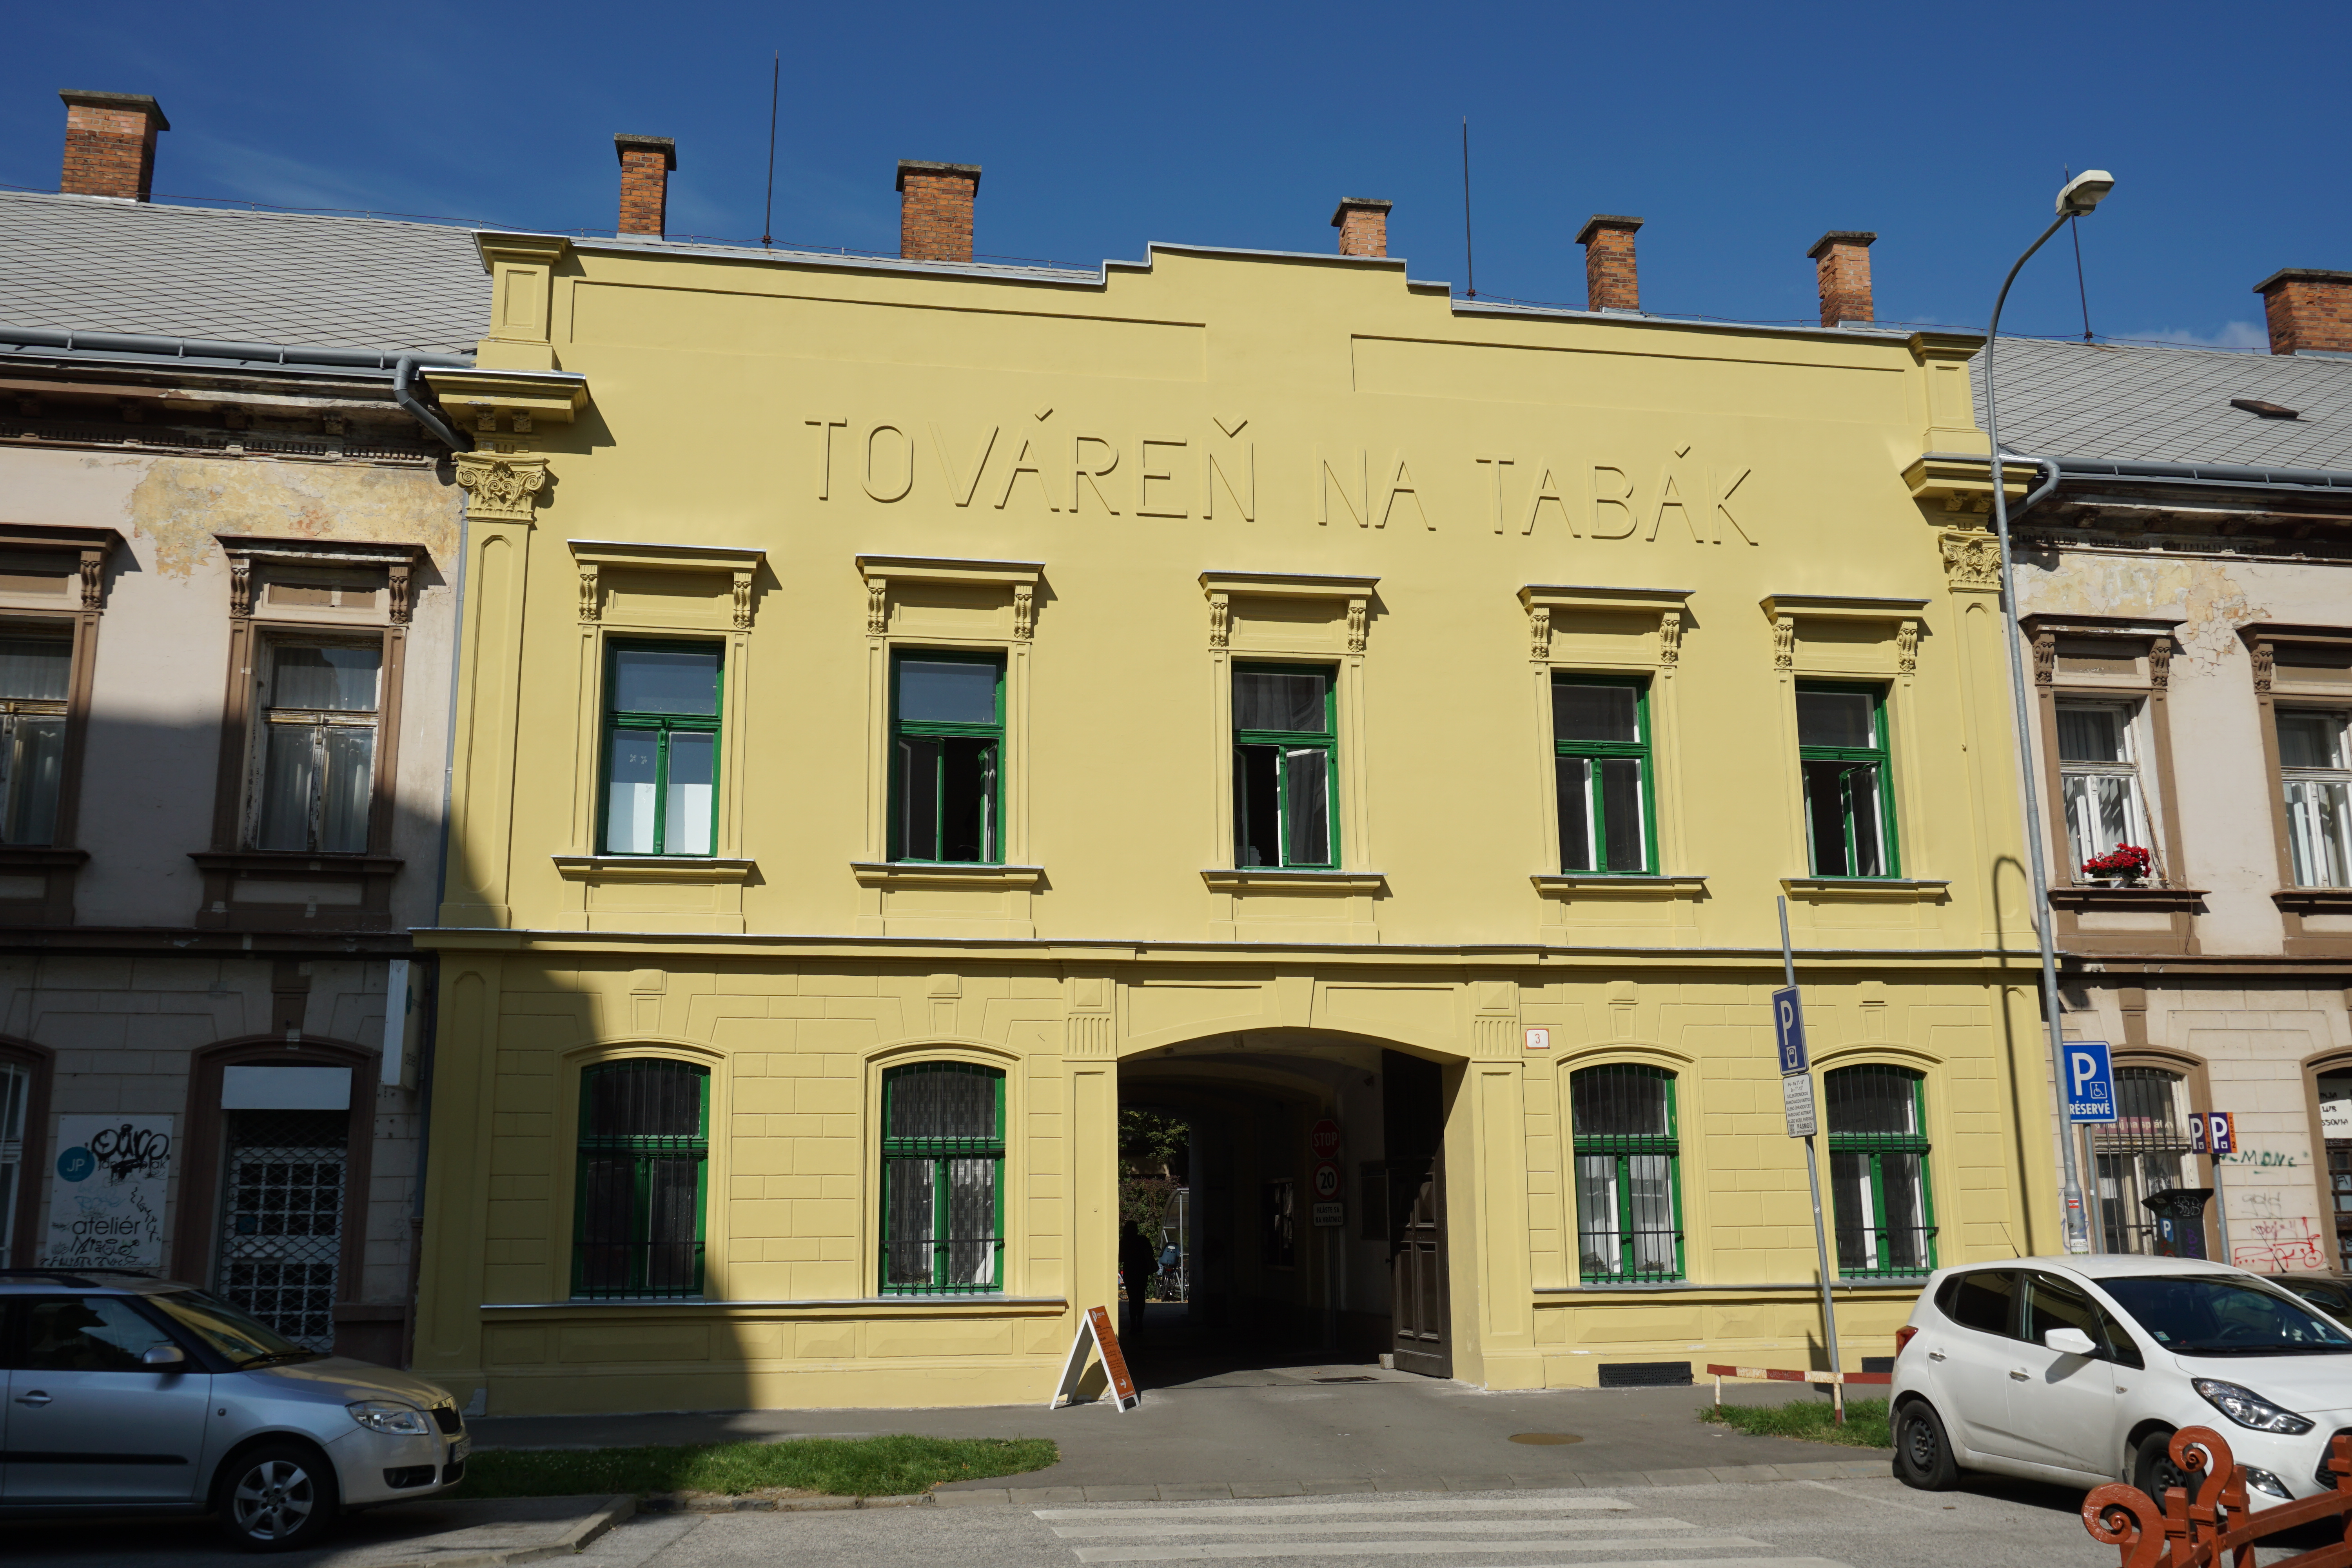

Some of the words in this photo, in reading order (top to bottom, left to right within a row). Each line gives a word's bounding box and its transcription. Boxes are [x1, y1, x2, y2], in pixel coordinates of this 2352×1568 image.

[804, 402, 1254, 523] TOVÁREŇ
[1316, 443, 1436, 531] NA
[1475, 440, 1759, 546] TABÁK
[1780, 1000, 1793, 1045] P
[1535, 1033, 1540, 1044] 3
[2072, 1053, 2096, 1096] P
[2069, 1100, 2111, 1114] RÉSERVÉ
[1314, 1132, 1338, 1147] STOP
[2190, 1118, 2203, 1149] P
[2211, 1117, 2227, 1149] P
[66, 1158, 85, 1172] JP
[1320, 1171, 1334, 1189] 20
[72, 1215, 140, 1235] ateliér
[2163, 1220, 2171, 1238] P
